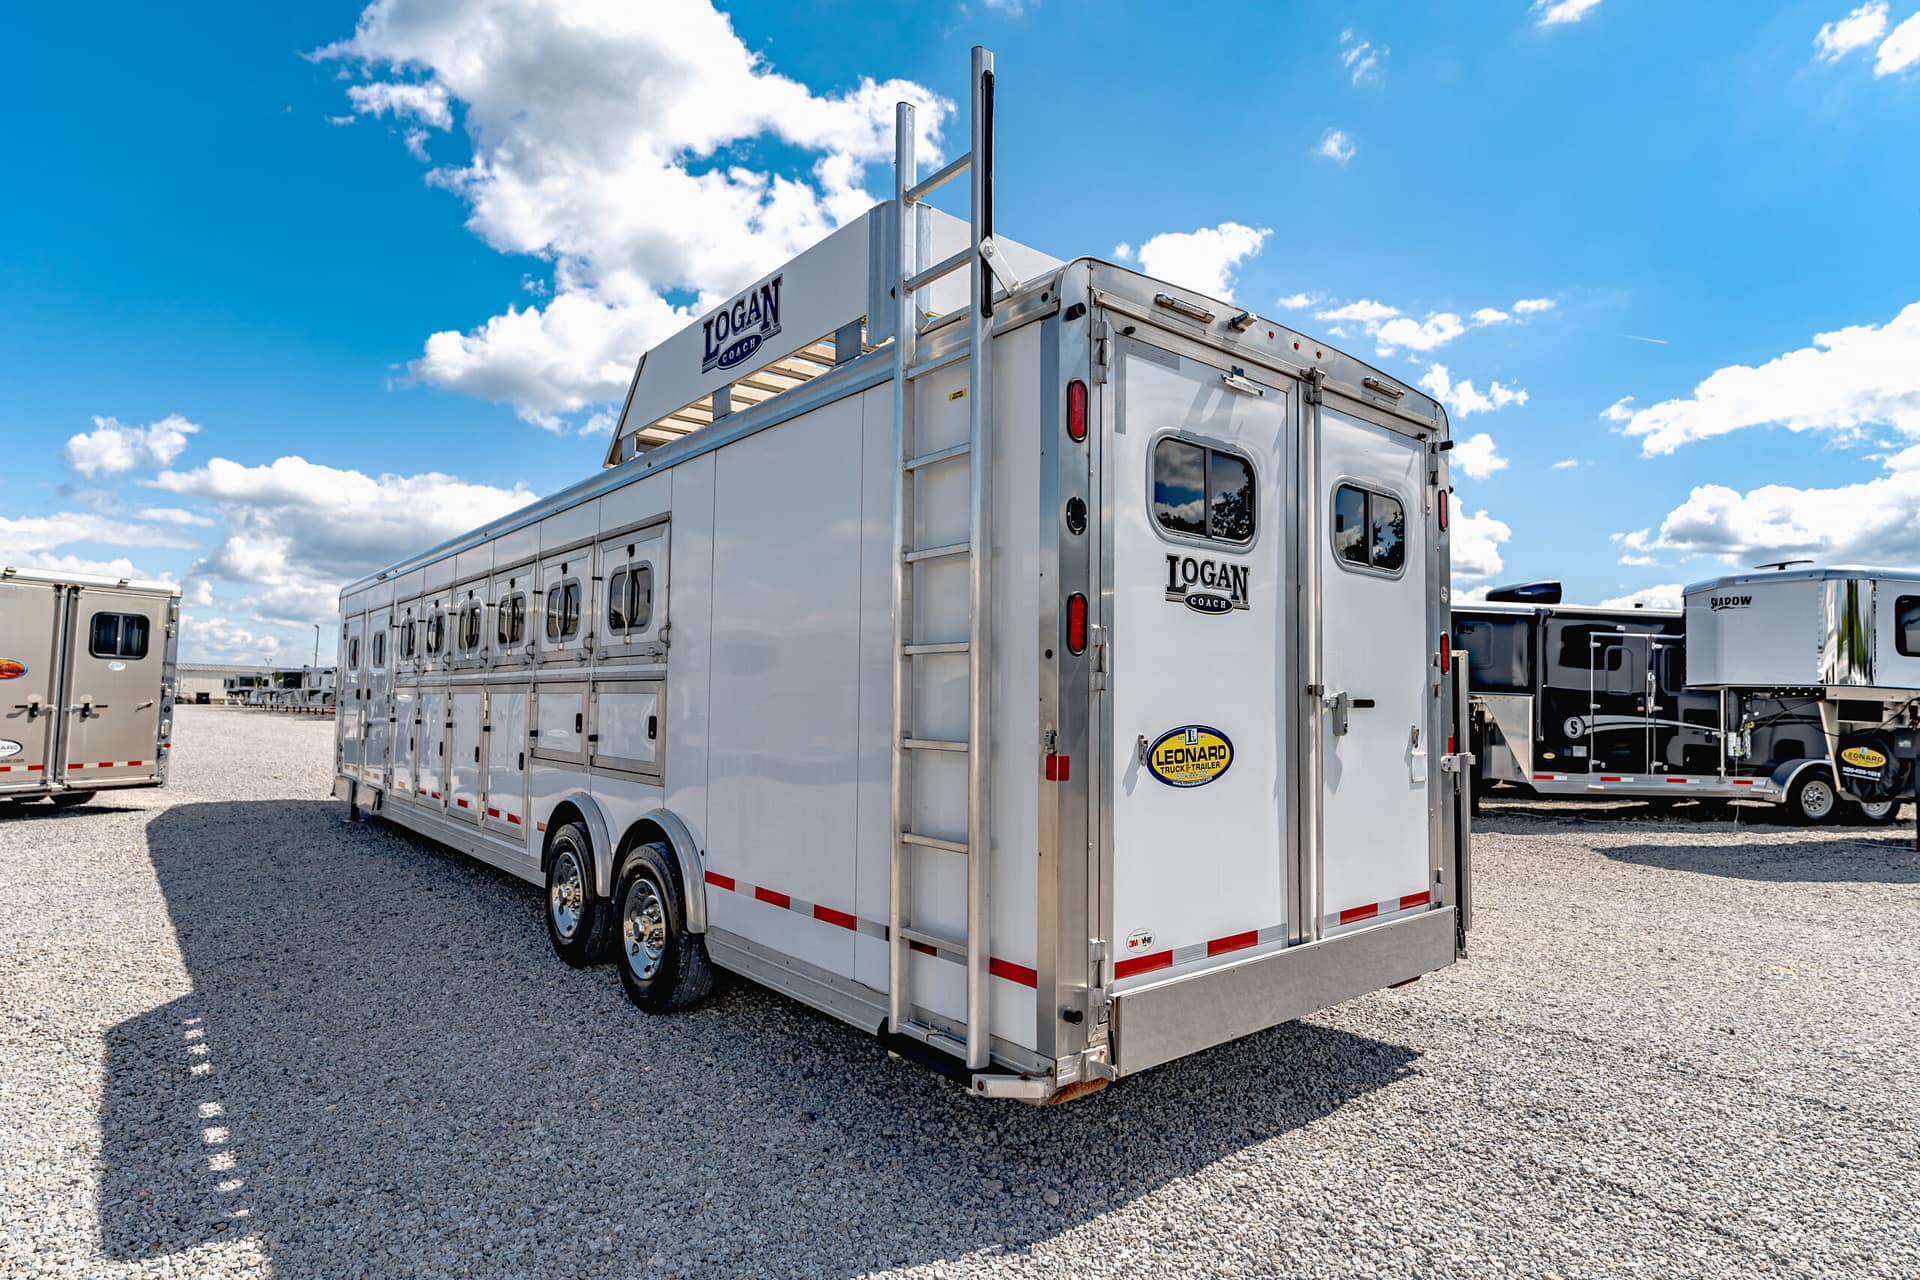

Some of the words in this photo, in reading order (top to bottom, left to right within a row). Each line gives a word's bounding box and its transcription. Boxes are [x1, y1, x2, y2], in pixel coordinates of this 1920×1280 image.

[702, 274, 783, 363] LOGAN
[722, 338, 756, 363] COACH
[1166, 554, 1249, 602] LOGAN
[1190, 597, 1226, 609] COACH
[1711, 596, 1752, 609] SHADOW
[1570, 720, 1578, 735] S
[1156, 745, 1227, 766] LEONARD
[1843, 751, 1884, 763] LEONARD
[1160, 764, 1185, 774] TRUCK
[1191, 761, 1221, 771] TRAILER
